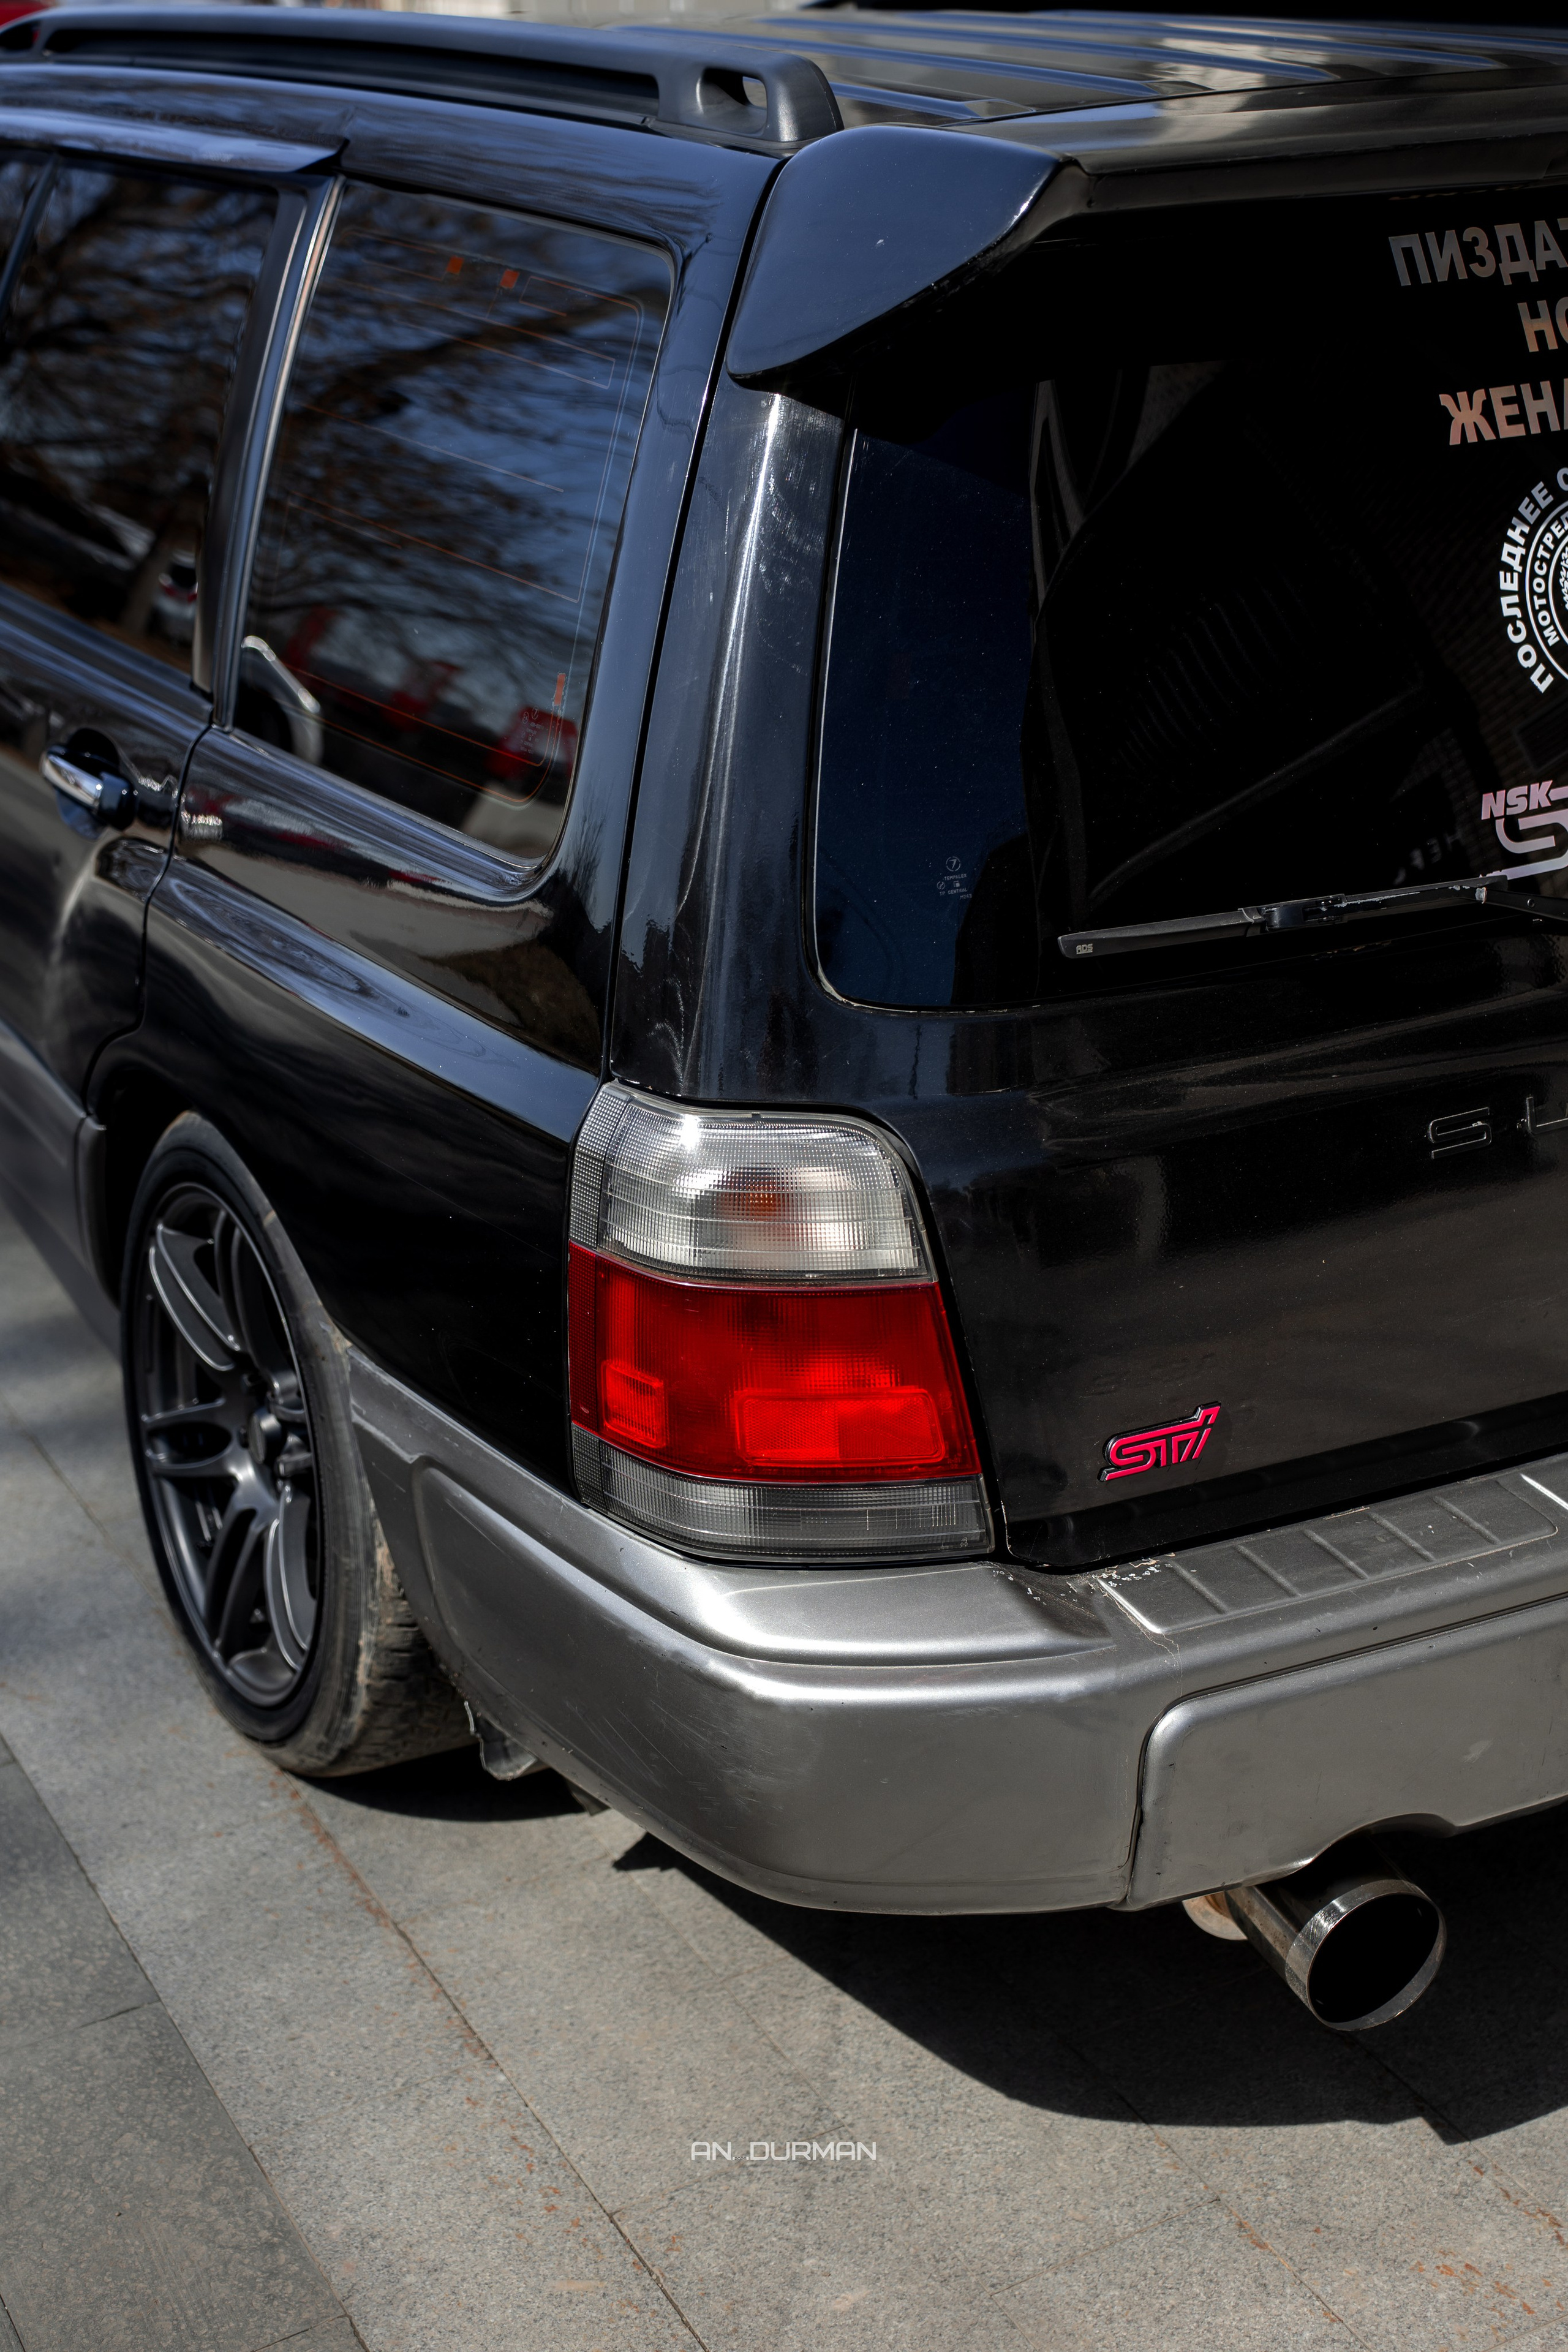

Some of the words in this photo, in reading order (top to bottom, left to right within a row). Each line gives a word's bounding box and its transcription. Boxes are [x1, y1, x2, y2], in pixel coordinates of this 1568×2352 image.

[1389, 217, 1568, 286] ПИЗДА
[1439, 378, 1568, 446] ЖЕН
[1499, 481, 1554, 693] ПОСЛЕДНЕЕ
